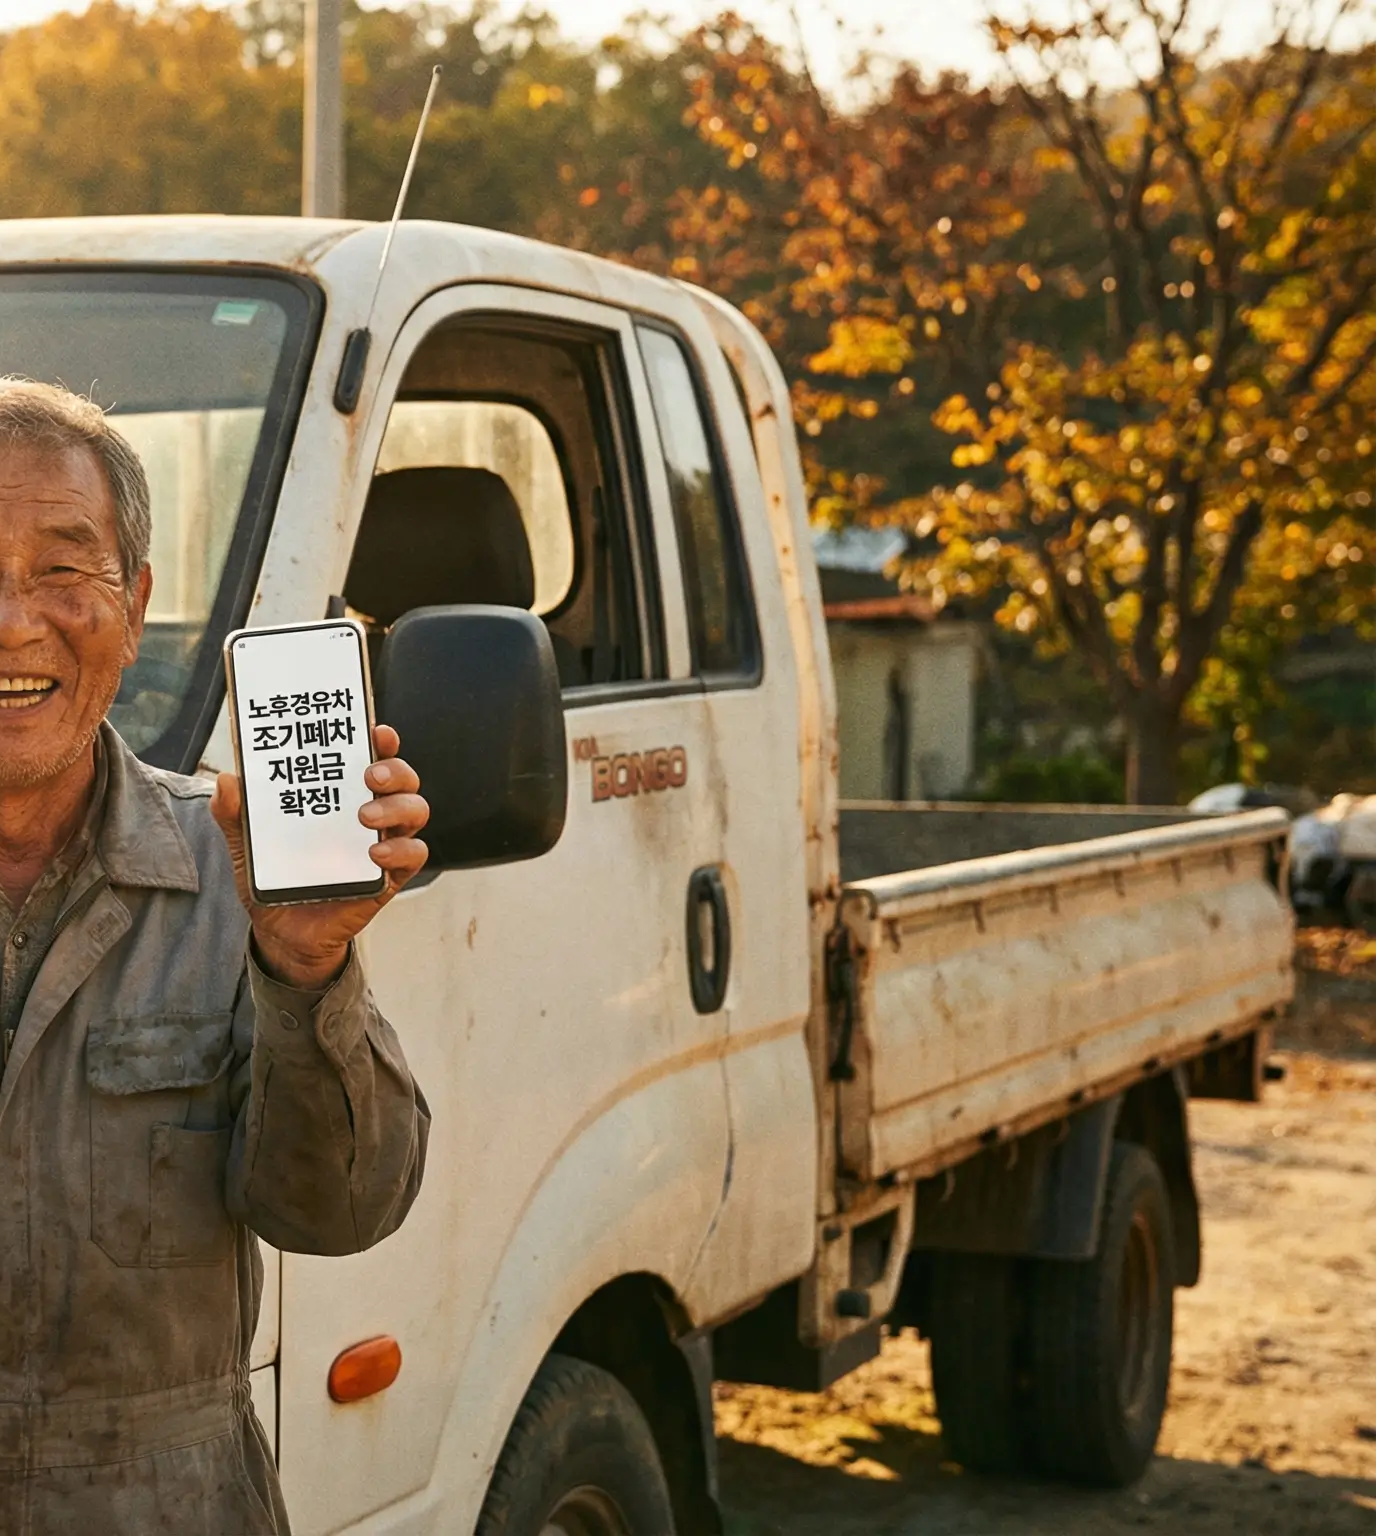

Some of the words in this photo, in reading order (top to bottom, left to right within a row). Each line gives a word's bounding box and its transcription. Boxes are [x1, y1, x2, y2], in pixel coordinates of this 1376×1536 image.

[248, 687, 354, 719] 노후경유차
[252, 716, 356, 751] 조기폐차
[268, 752, 346, 785] 지원금
[591, 745, 688, 803] BONGO
[279, 787, 341, 817] 확정!
